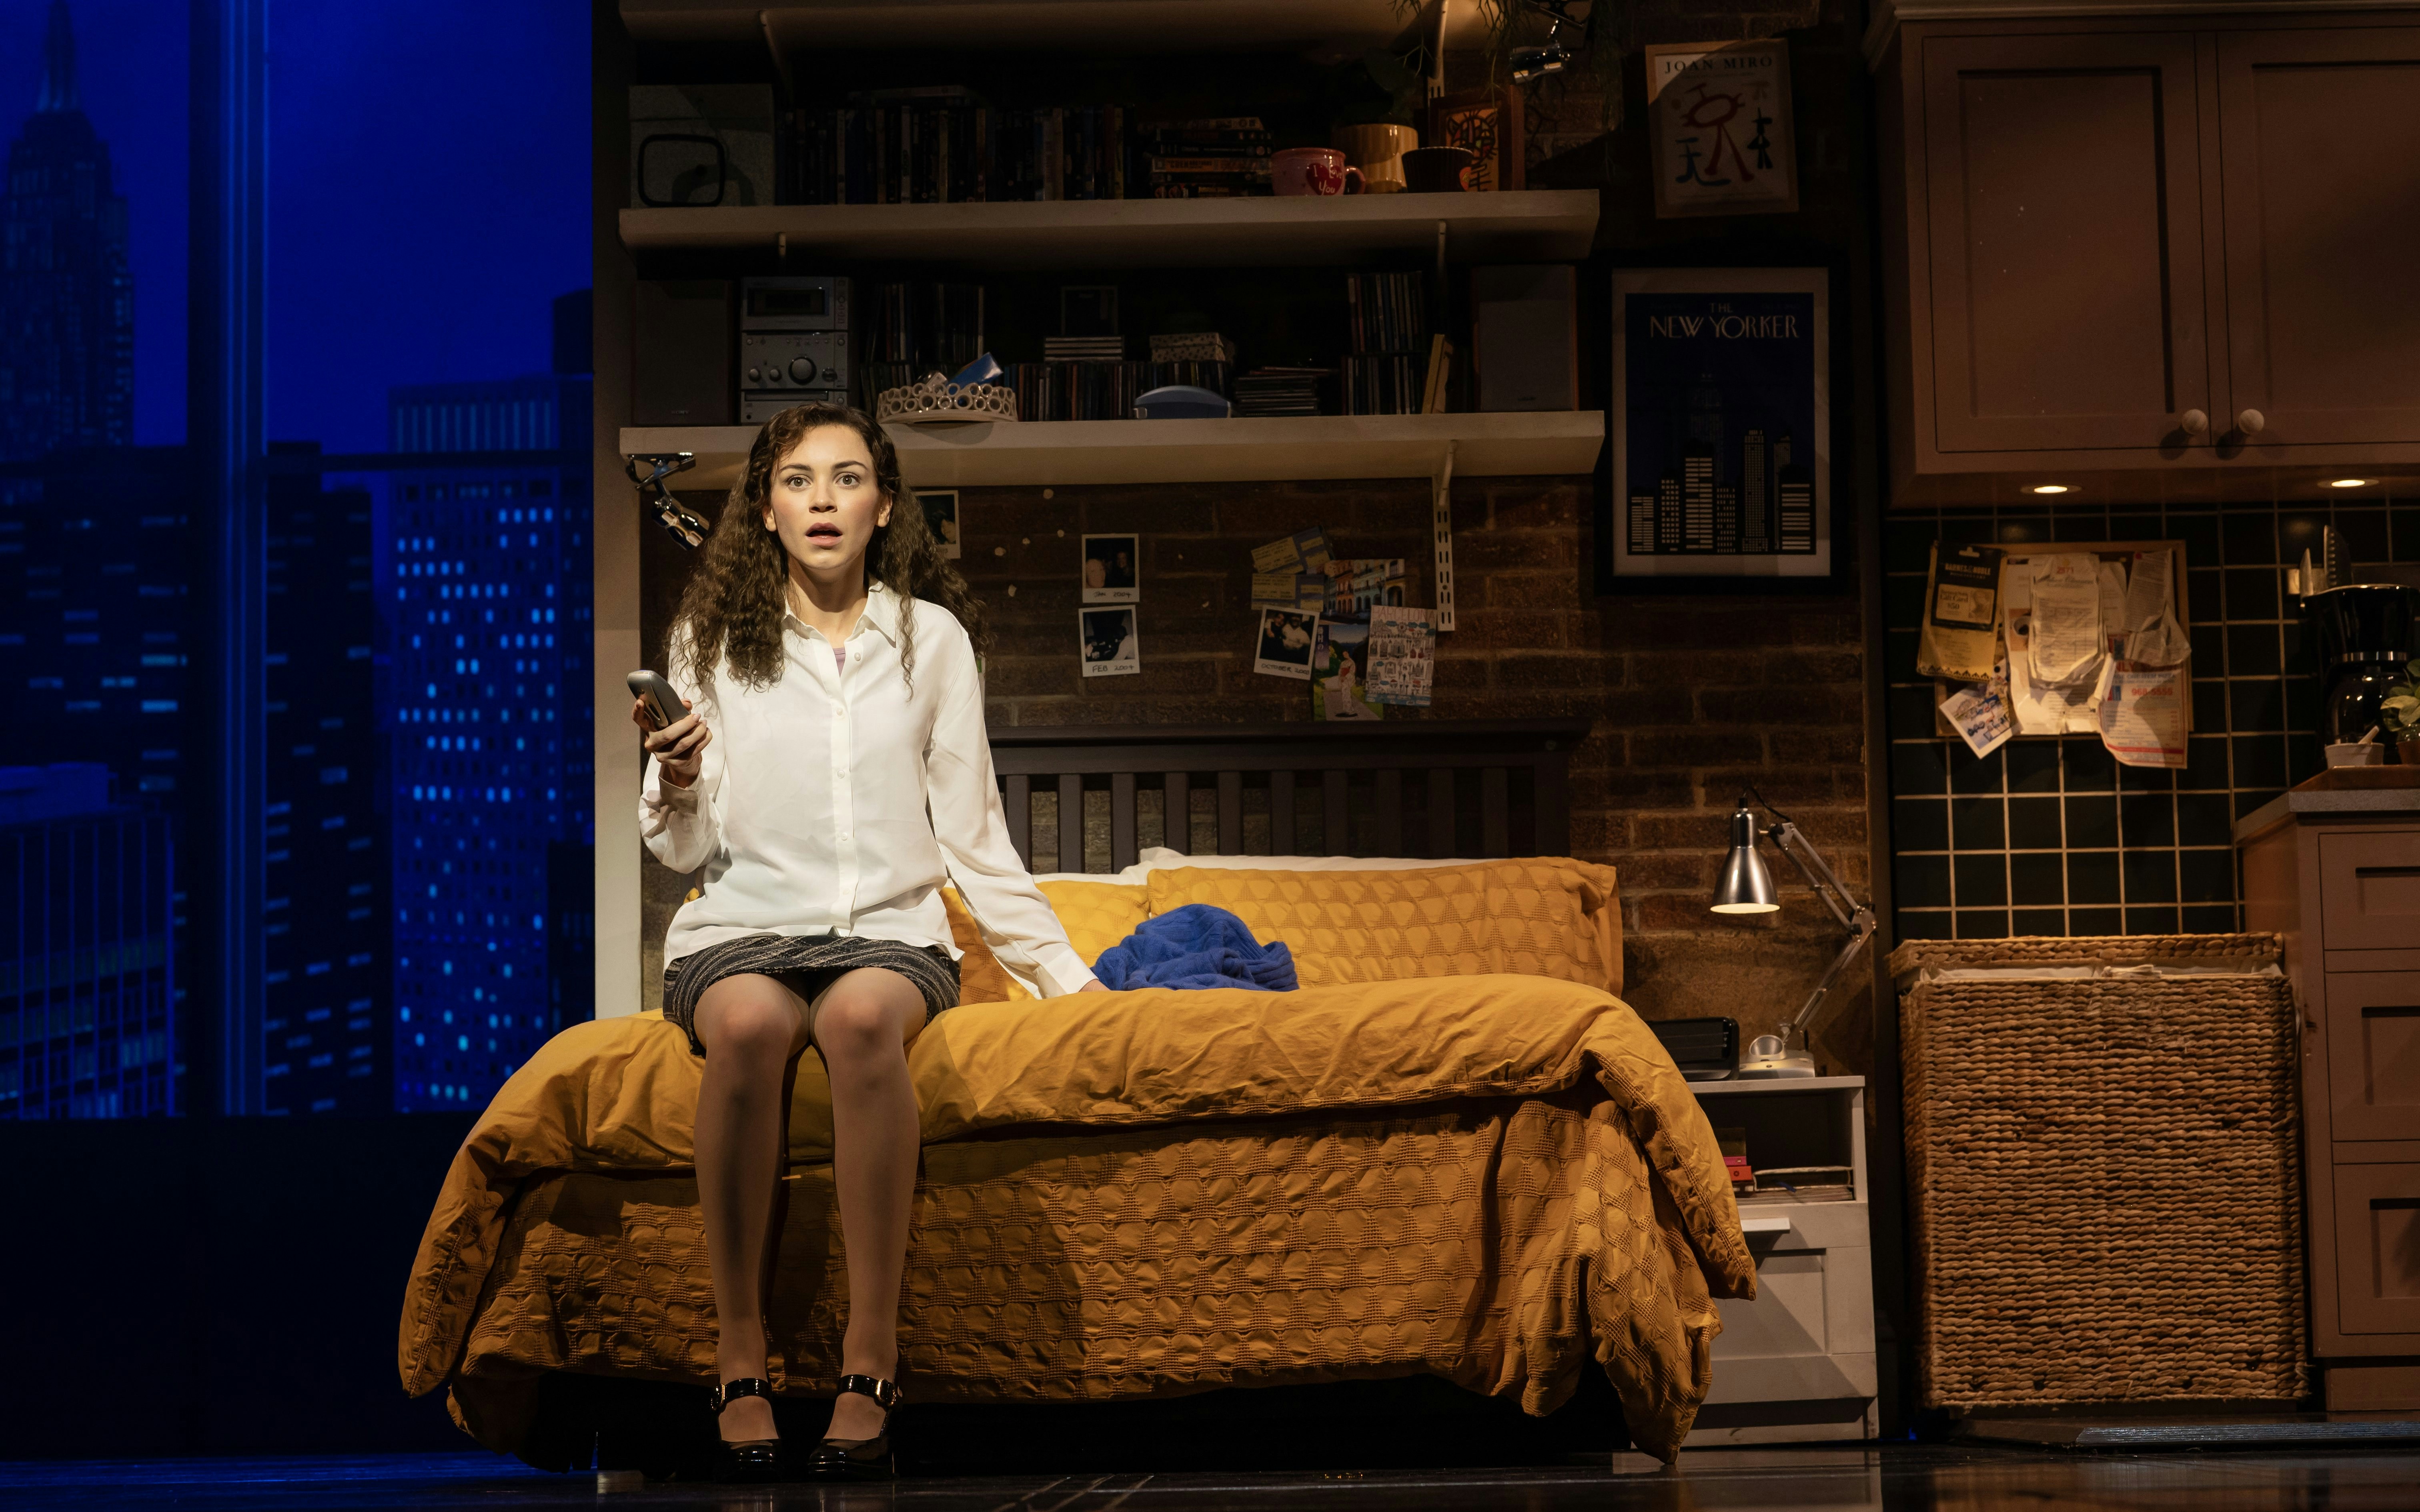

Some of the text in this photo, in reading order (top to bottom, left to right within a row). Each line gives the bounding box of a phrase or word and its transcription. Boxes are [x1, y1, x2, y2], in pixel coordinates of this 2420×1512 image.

[1665, 58, 1713, 74] JOAN
[1313, 165, 1318, 177] I
[1318, 180, 1335, 195] You
[1709, 302, 1733, 313] THE
[1650, 315, 1799, 339] NEW YORKER
[1261, 663, 1292, 672] OCTOBER
